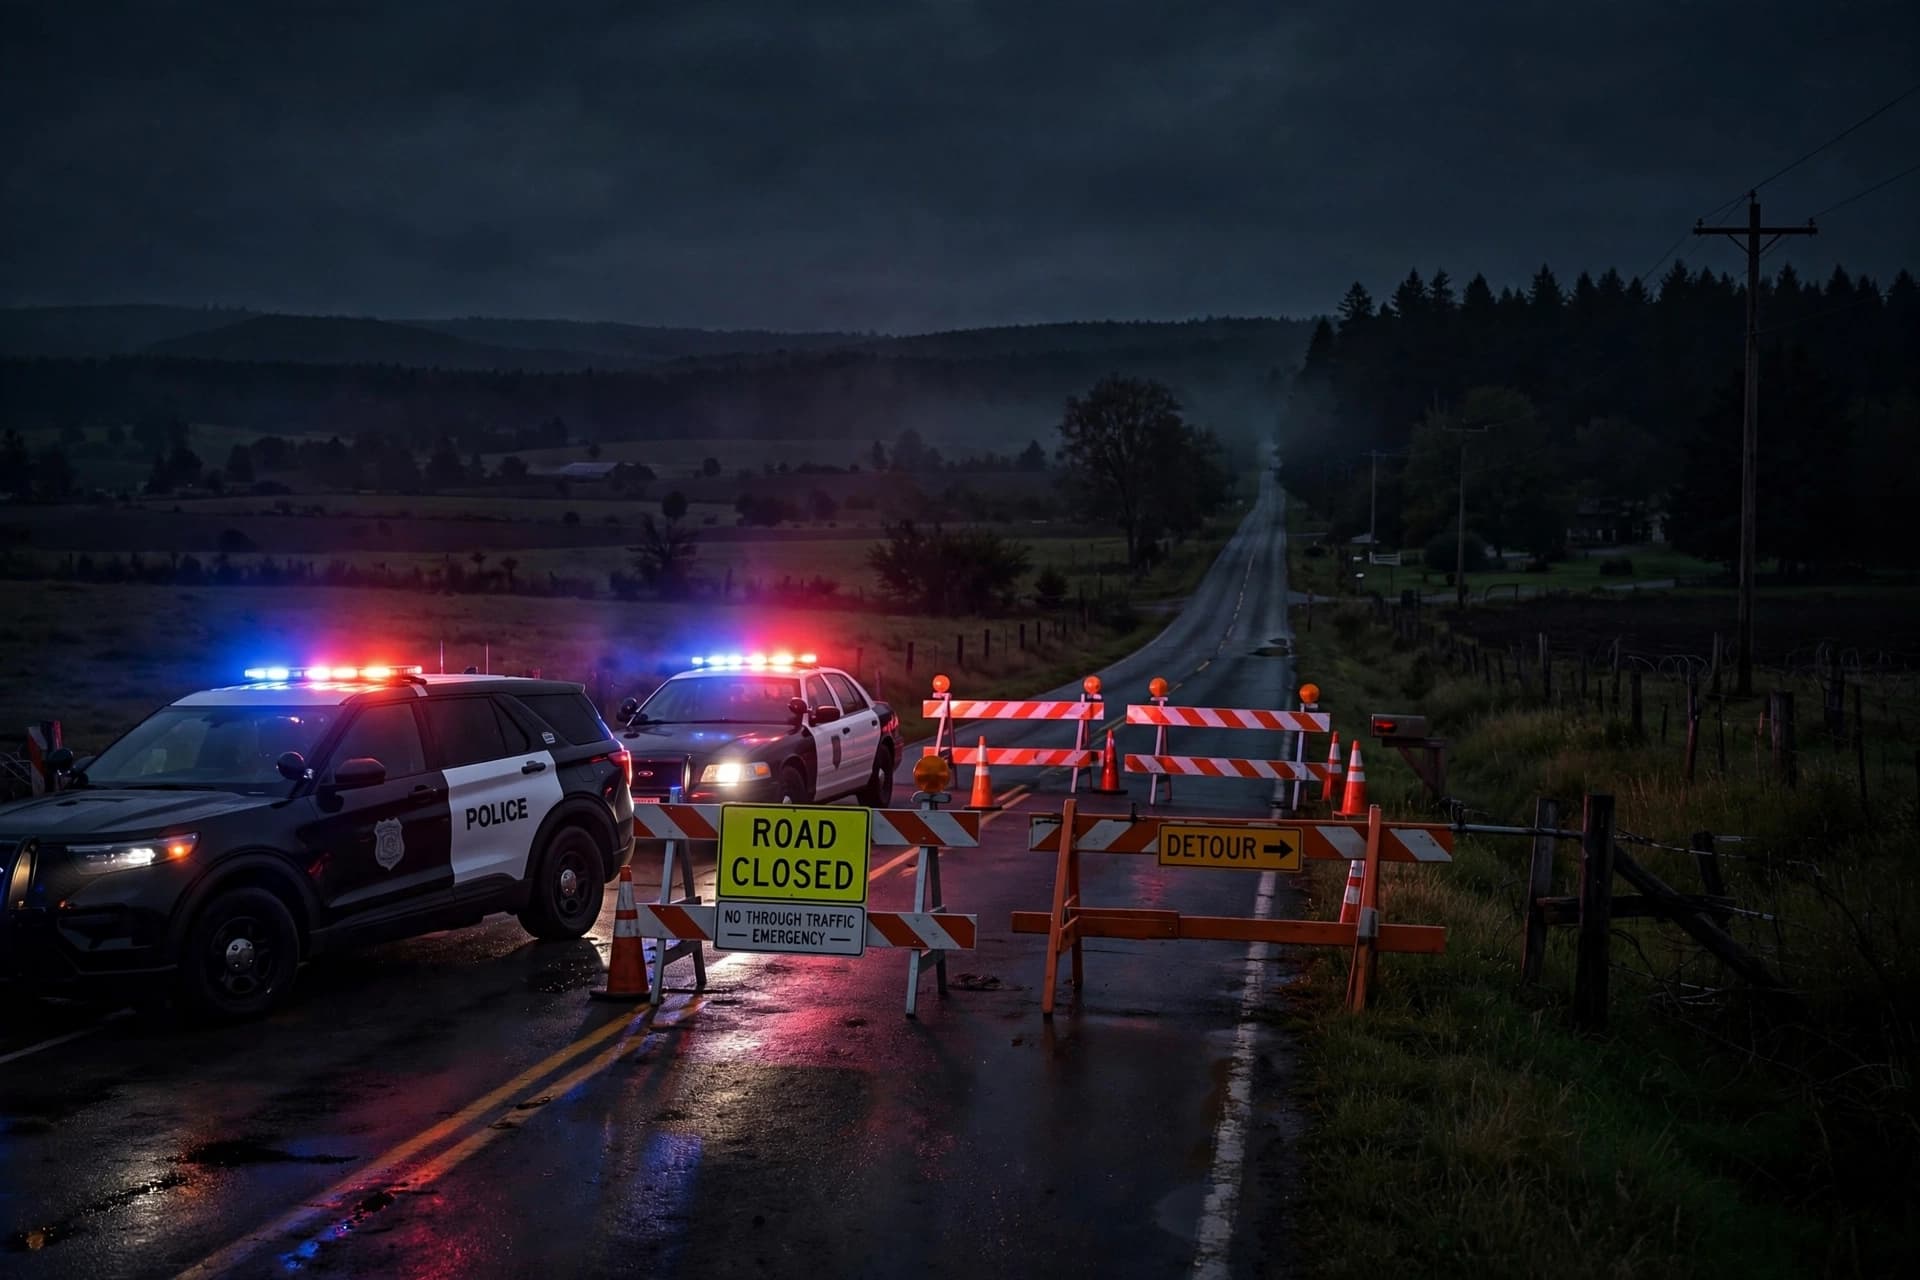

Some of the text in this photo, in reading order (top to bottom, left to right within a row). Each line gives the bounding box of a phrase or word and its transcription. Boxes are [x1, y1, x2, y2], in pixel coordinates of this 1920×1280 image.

[466, 798, 528, 830] POLICE
[752, 818, 836, 849] ROAD
[1167, 834, 1257, 860] DETOUR
[732, 857, 853, 890] CLOSED
[725, 910, 855, 929] NO THROUGH TRAFFIC
[752, 929, 825, 945] EMERGENCY
